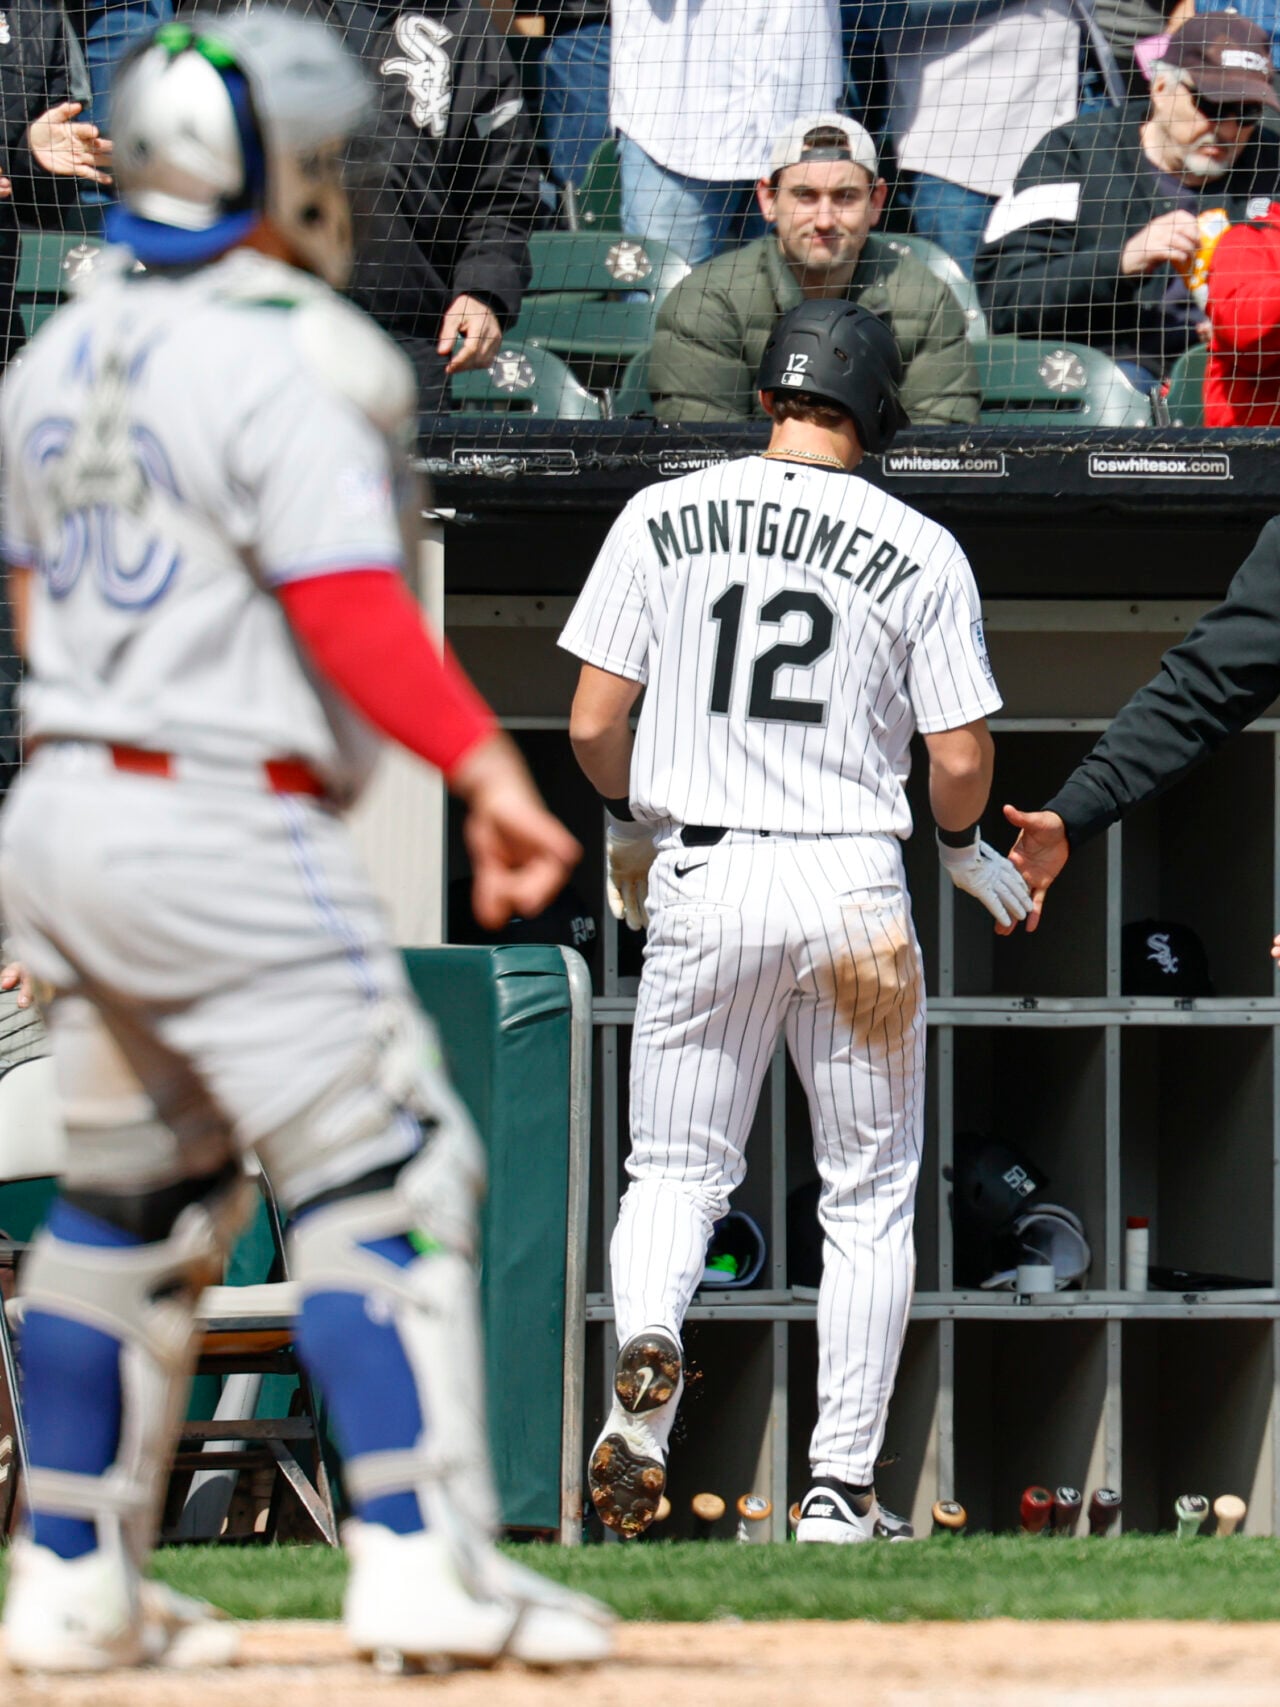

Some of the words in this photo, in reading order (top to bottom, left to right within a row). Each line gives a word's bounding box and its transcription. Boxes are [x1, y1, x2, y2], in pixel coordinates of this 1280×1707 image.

[786, 353, 809, 373] 12
[889, 454, 998, 472] whitesox.com
[1093, 453, 1225, 474] loswhitesox.com
[647, 499, 921, 603] MONTGOMERY
[707, 581, 839, 728] 12
[807, 1503, 835, 1517] NIKE
